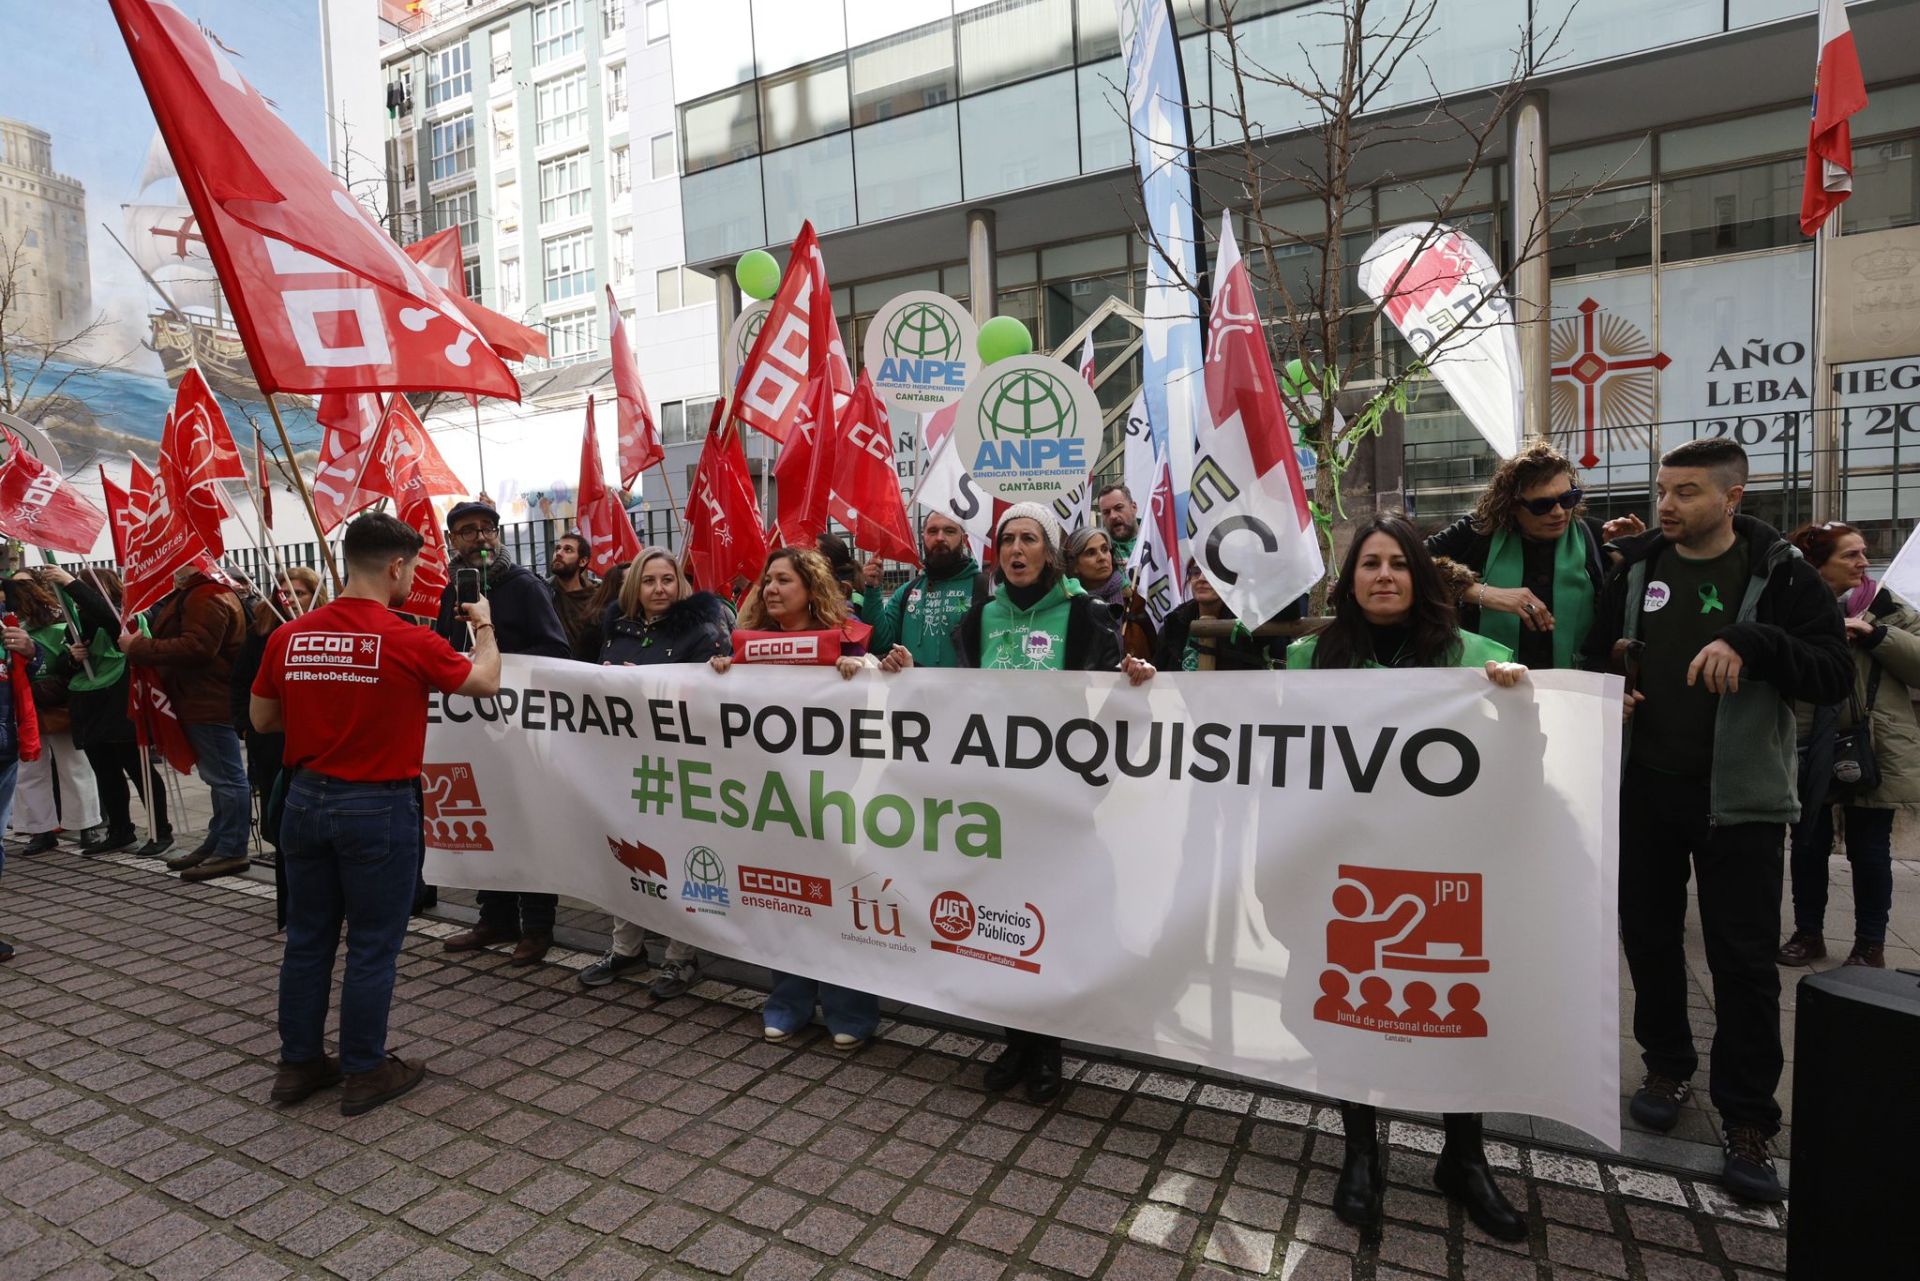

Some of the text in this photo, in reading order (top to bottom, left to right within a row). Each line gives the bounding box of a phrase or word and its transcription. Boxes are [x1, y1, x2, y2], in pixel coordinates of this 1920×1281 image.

[1707, 338, 1805, 372] AÑO
[876, 358, 966, 386] ANPE
[875, 382, 965, 392] SINDICATO INDEPENDIENTE
[895, 392, 945, 402] CANTABRIA
[973, 438, 1087, 470] ANPE
[973, 469, 1086, 479] SINDICATO INDEPENDIENTE
[999, 481, 1062, 492] CANTABRIA
[293, 636, 354, 653] CCOO
[748, 641, 794, 657] CCOO
[1026, 647, 1048, 655] STEC
[291, 653, 353, 664] enseñanza
[285, 671, 380, 684] #ElRetoDeEducar
[648, 698, 707, 747] EL
[720, 702, 931, 764] PODER
[951, 713, 1481, 798] ADQUISITIVO
[452, 766, 468, 782] JPD
[631, 755, 1002, 860] #EsAhora
[630, 877, 668, 900] STEC
[681, 880, 730, 905] ANPE
[742, 871, 802, 896] CCOO
[1432, 880, 1470, 907] JPD
[741, 894, 812, 917] enseñanza
[848, 878, 906, 938] tú
[936, 898, 969, 922] UGT
[977, 905, 1031, 929] Servicios
[841, 931, 917, 953] trabajadores unidos
[977, 922, 1025, 946] Públicos
[956, 945, 1015, 967] Enseñanza Cantabria
[1337, 1009, 1462, 1033] Junta de personal docente
[1384, 1034, 1412, 1043] Cantabria
